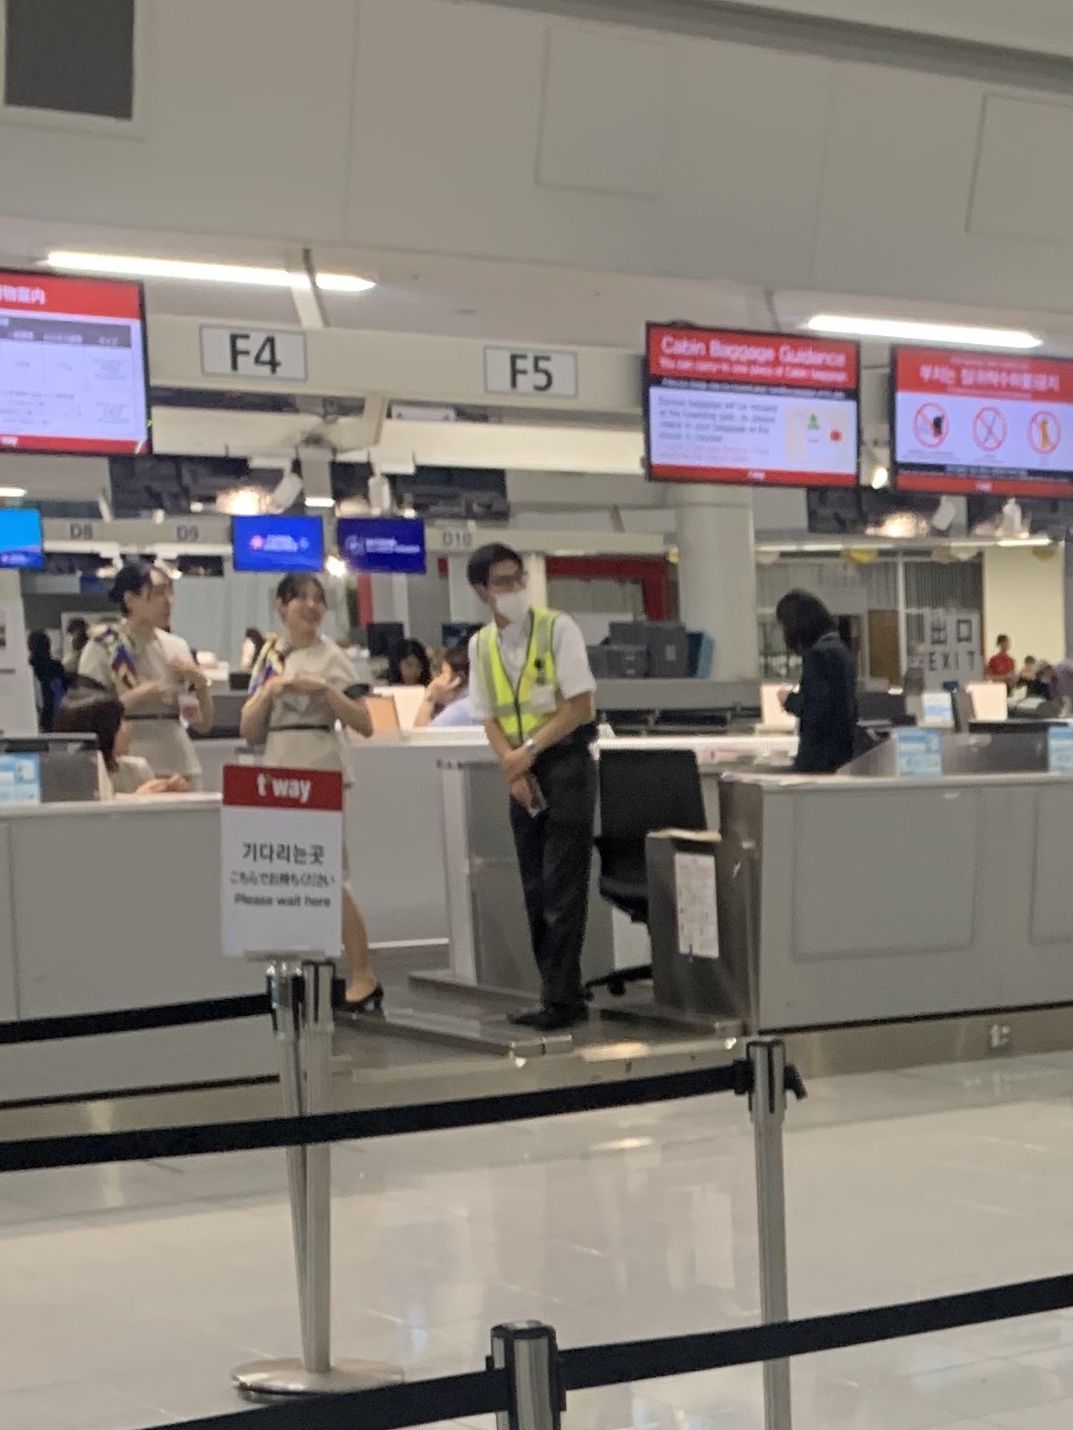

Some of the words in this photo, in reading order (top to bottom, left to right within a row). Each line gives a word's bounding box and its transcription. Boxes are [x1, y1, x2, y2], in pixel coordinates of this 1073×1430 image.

[229, 333, 281, 374] F4
[661, 335, 706, 355] Cabin
[709, 339, 775, 363] Baggage
[778, 344, 846, 367] Guidance
[510, 353, 553, 391] F5
[176, 525, 199, 542] D9
[928, 650, 976, 672] EXIT
[242, 842, 325, 865] 기다리는곳
[234, 892, 273, 907] Please
[277, 894, 301, 908] wait
[304, 894, 331, 909] here
